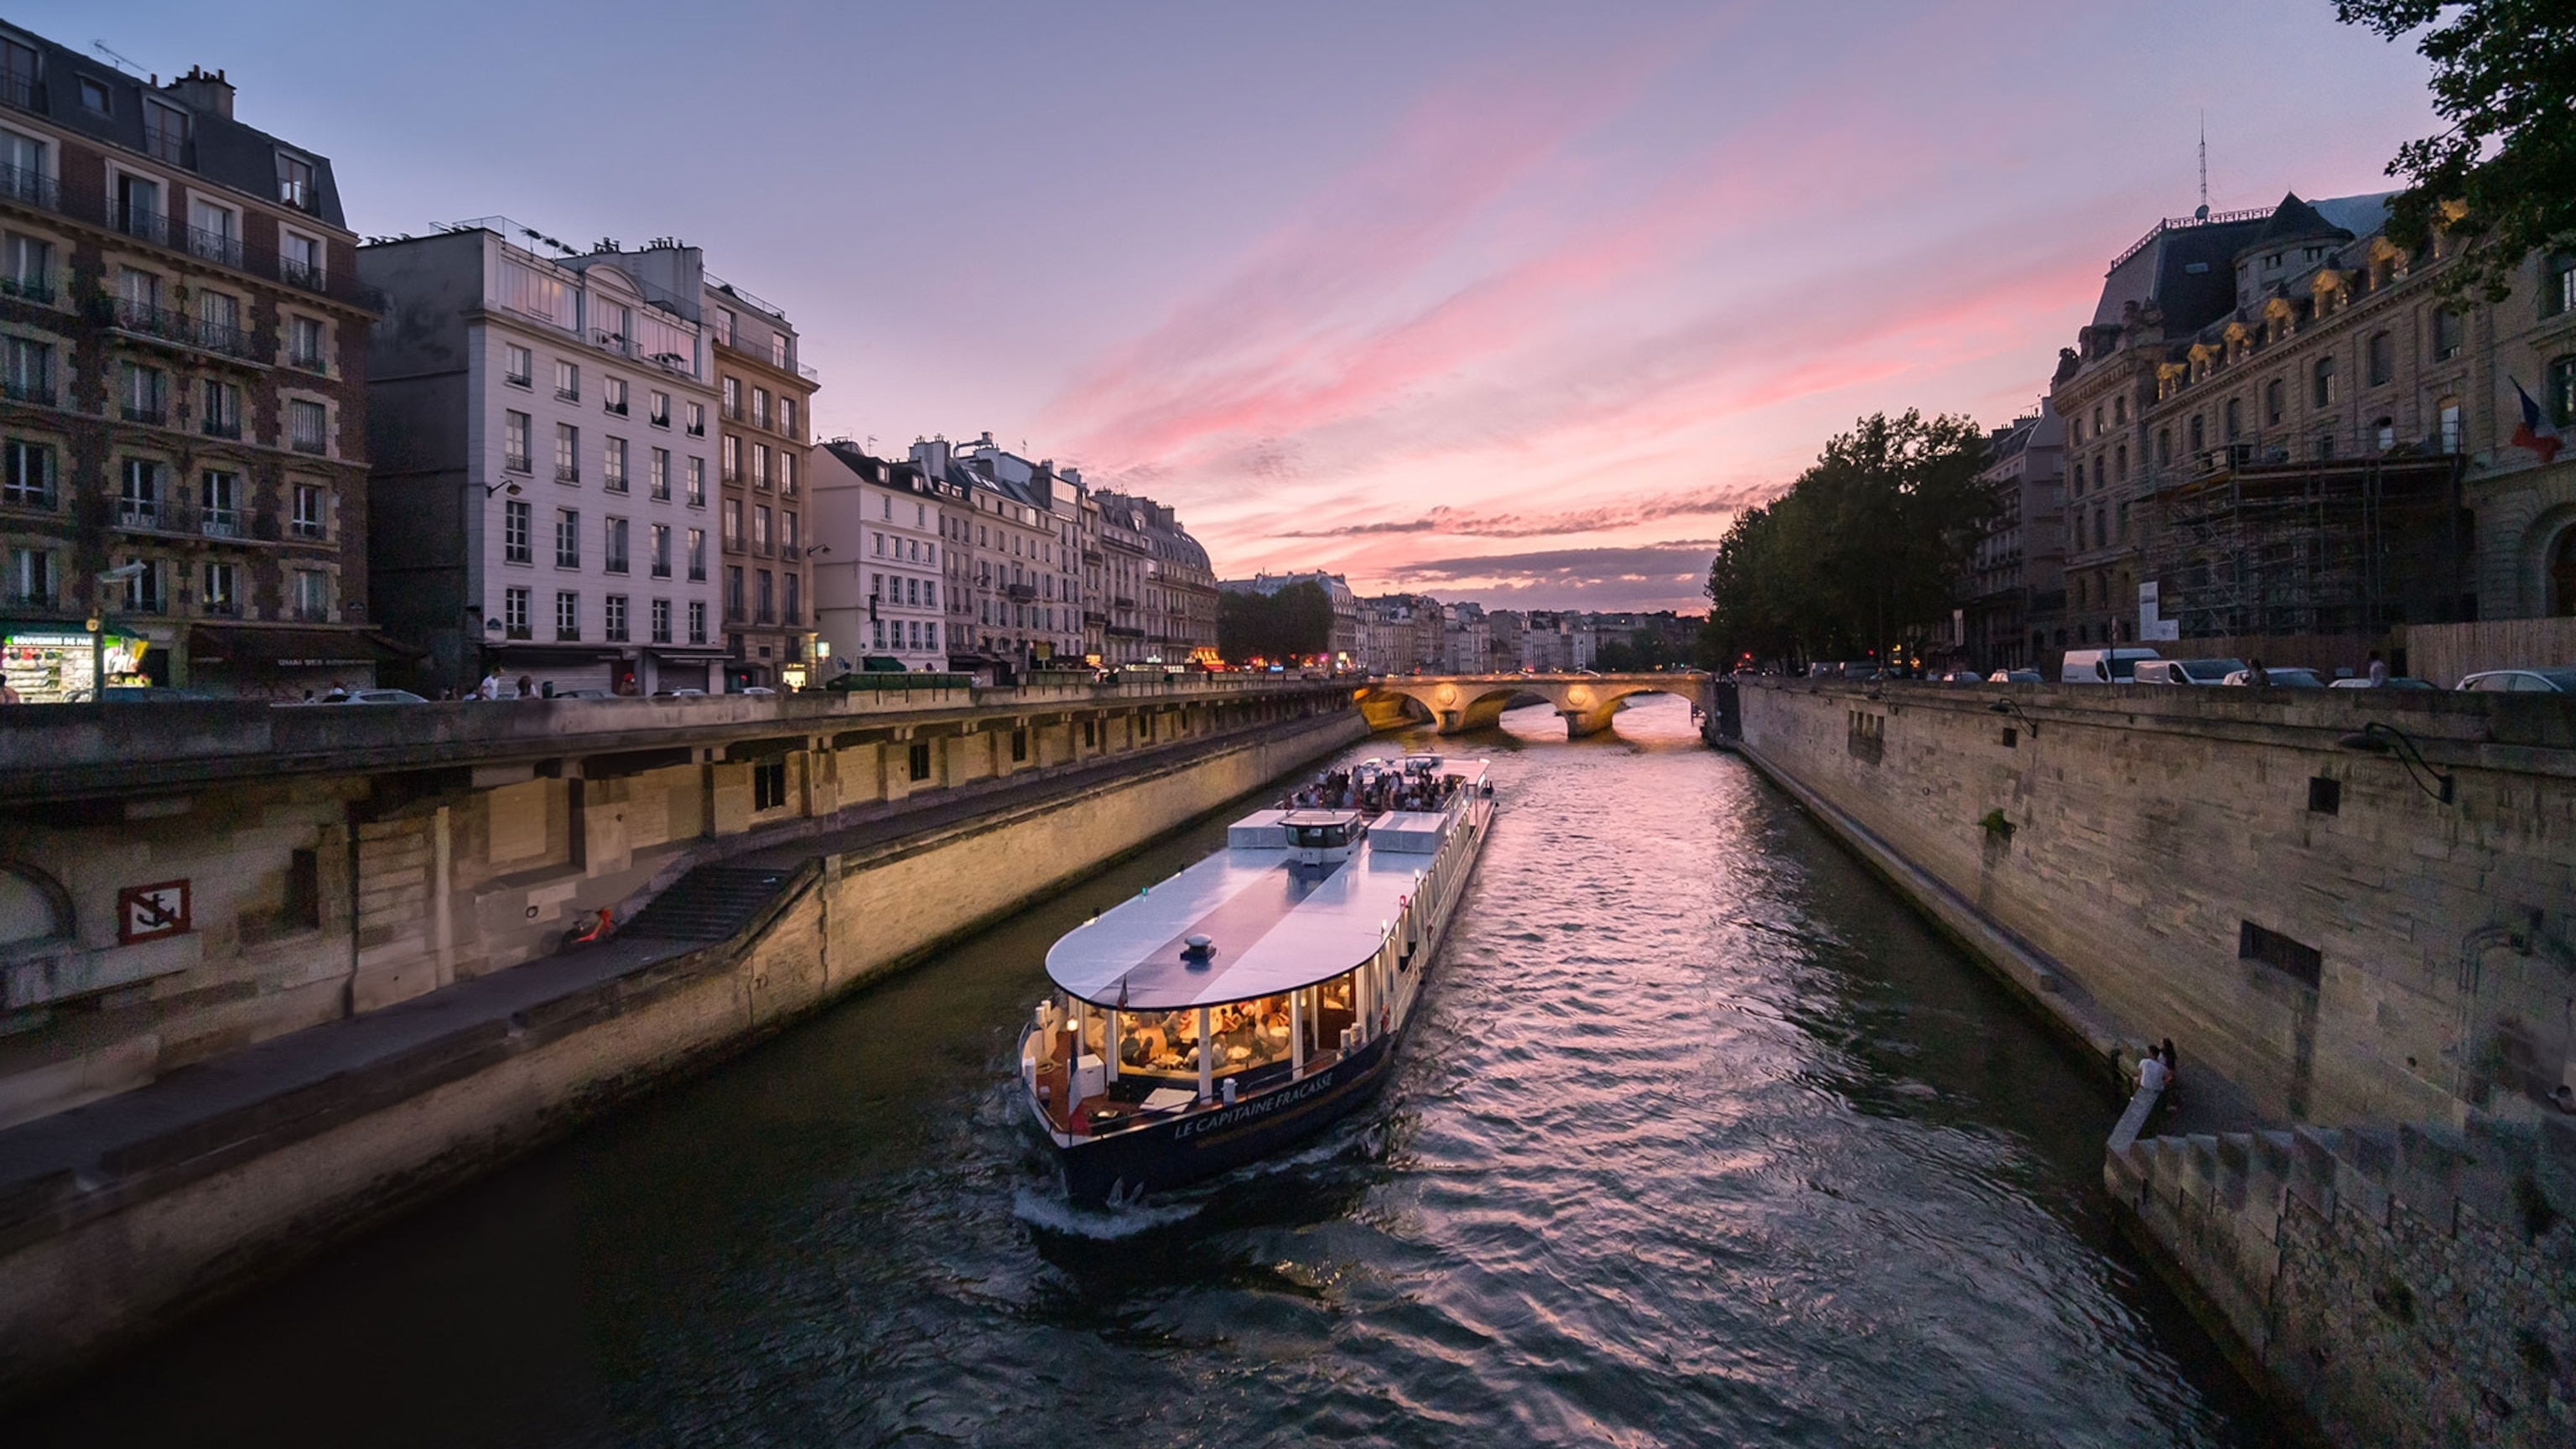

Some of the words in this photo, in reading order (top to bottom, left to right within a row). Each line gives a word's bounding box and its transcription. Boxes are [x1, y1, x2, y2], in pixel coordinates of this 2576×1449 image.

[13, 636, 62, 645] SOUVENIRS
[1175, 1122, 1193, 1140] LE
[1197, 1098, 1275, 1132] CAPITAINE
[1275, 1072, 1333, 1108] FRACASSE
